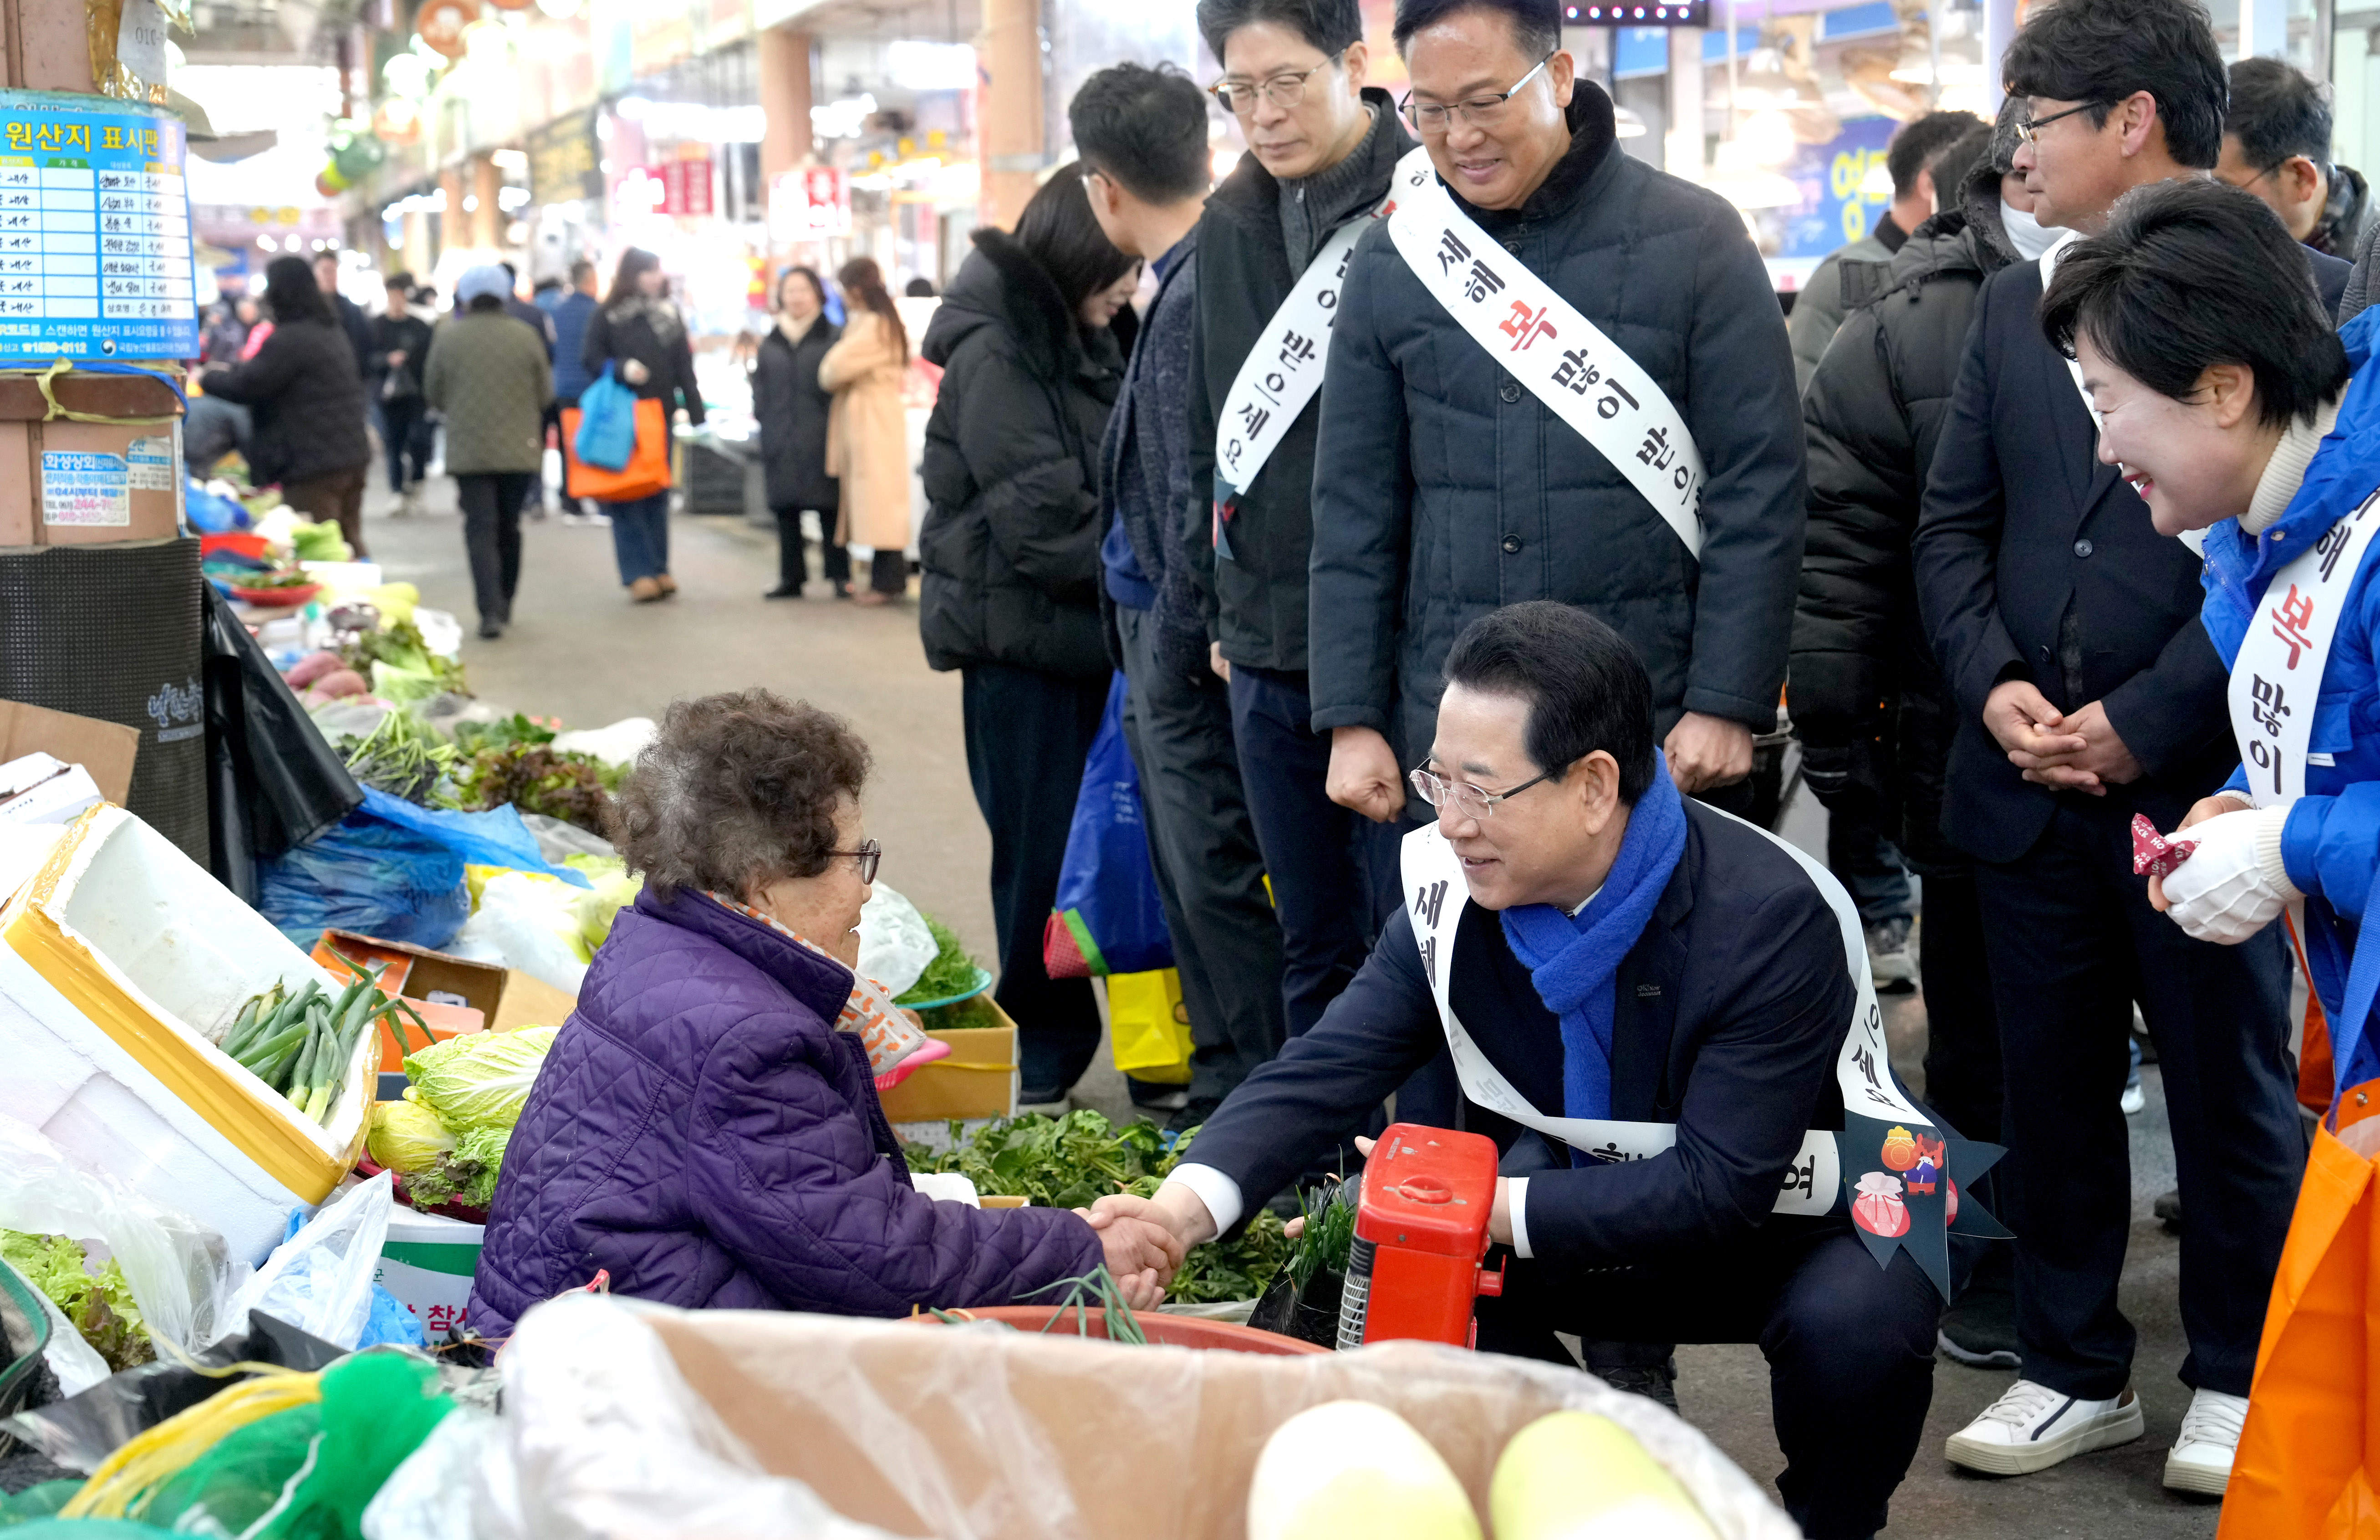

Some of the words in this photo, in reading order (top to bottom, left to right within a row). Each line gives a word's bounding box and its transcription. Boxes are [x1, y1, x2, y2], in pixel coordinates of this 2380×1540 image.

[5, 122, 90, 152] 원산지
[101, 126, 158, 157] 표시판
[1437, 228, 1505, 303] 새해
[1499, 300, 1557, 352] 복
[1551, 349, 1640, 419] 많이
[1220, 329, 1315, 472] 받으세요
[45, 454, 95, 470] 화성상회
[2272, 583, 2314, 670] 복
[2250, 673, 2291, 795] 많이
[1414, 880, 1448, 988] 새해
